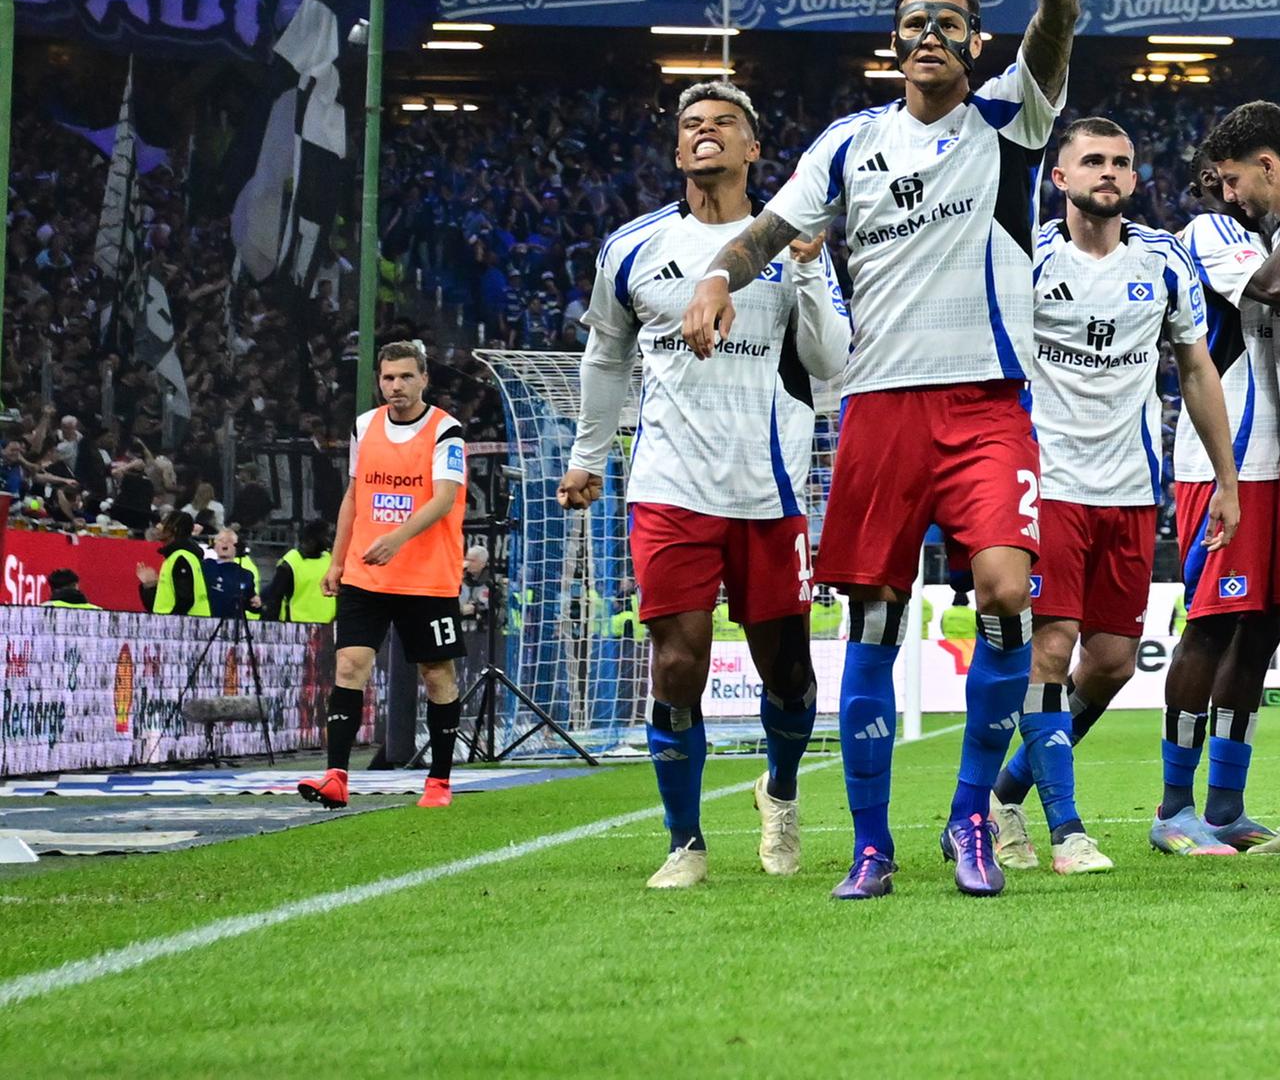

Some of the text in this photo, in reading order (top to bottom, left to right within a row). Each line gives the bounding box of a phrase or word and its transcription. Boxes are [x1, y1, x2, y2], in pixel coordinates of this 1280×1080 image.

[365, 471, 423, 489] uhlsport
[374, 493, 412, 510] LIQUI
[430, 617, 456, 646] 13
